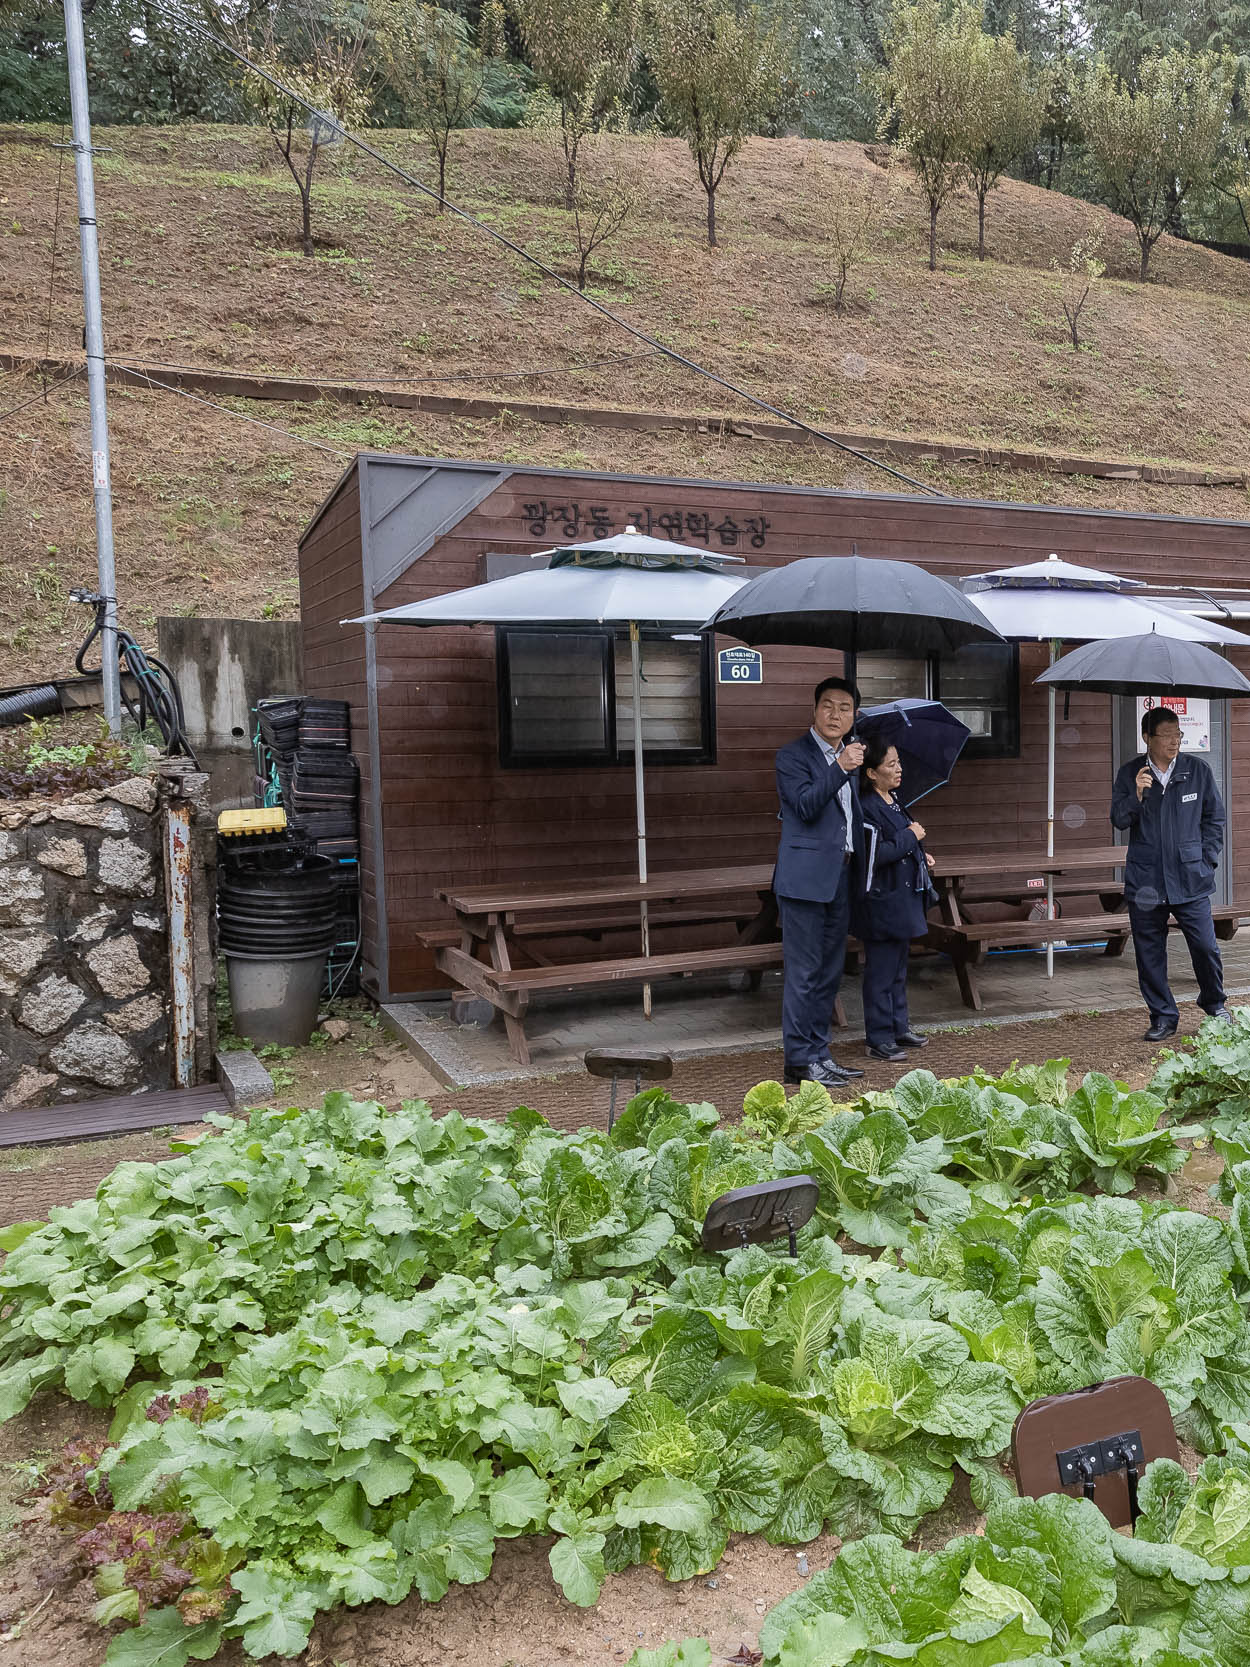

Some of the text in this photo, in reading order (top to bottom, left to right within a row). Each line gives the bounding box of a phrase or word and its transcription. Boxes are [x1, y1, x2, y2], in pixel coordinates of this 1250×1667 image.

[521, 500, 771, 548] 광장동 자연학습장
[732, 665, 750, 678] 60
